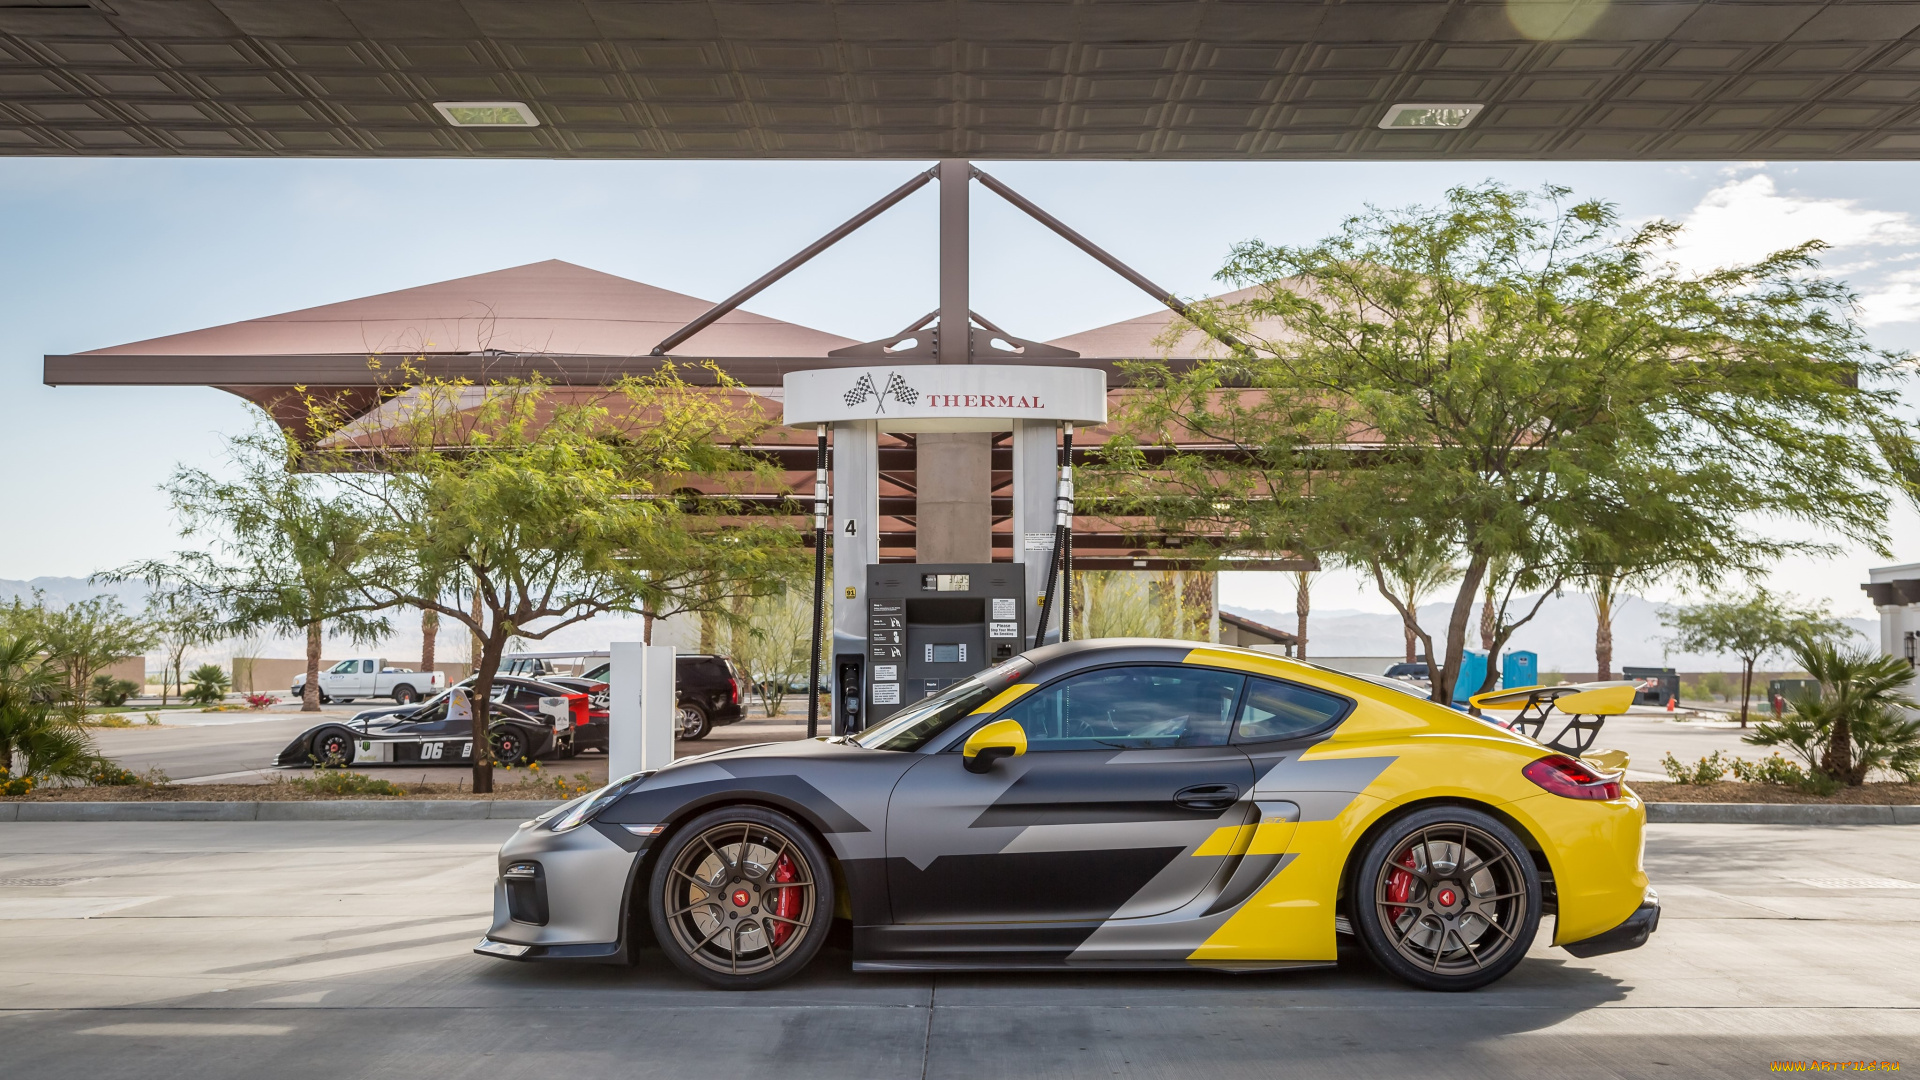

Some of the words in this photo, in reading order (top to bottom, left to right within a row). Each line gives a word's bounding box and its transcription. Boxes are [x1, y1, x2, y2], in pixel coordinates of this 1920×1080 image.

[926, 394, 1045, 409] THERMAL
[845, 519, 857, 536] 4
[420, 742, 444, 760] 06
